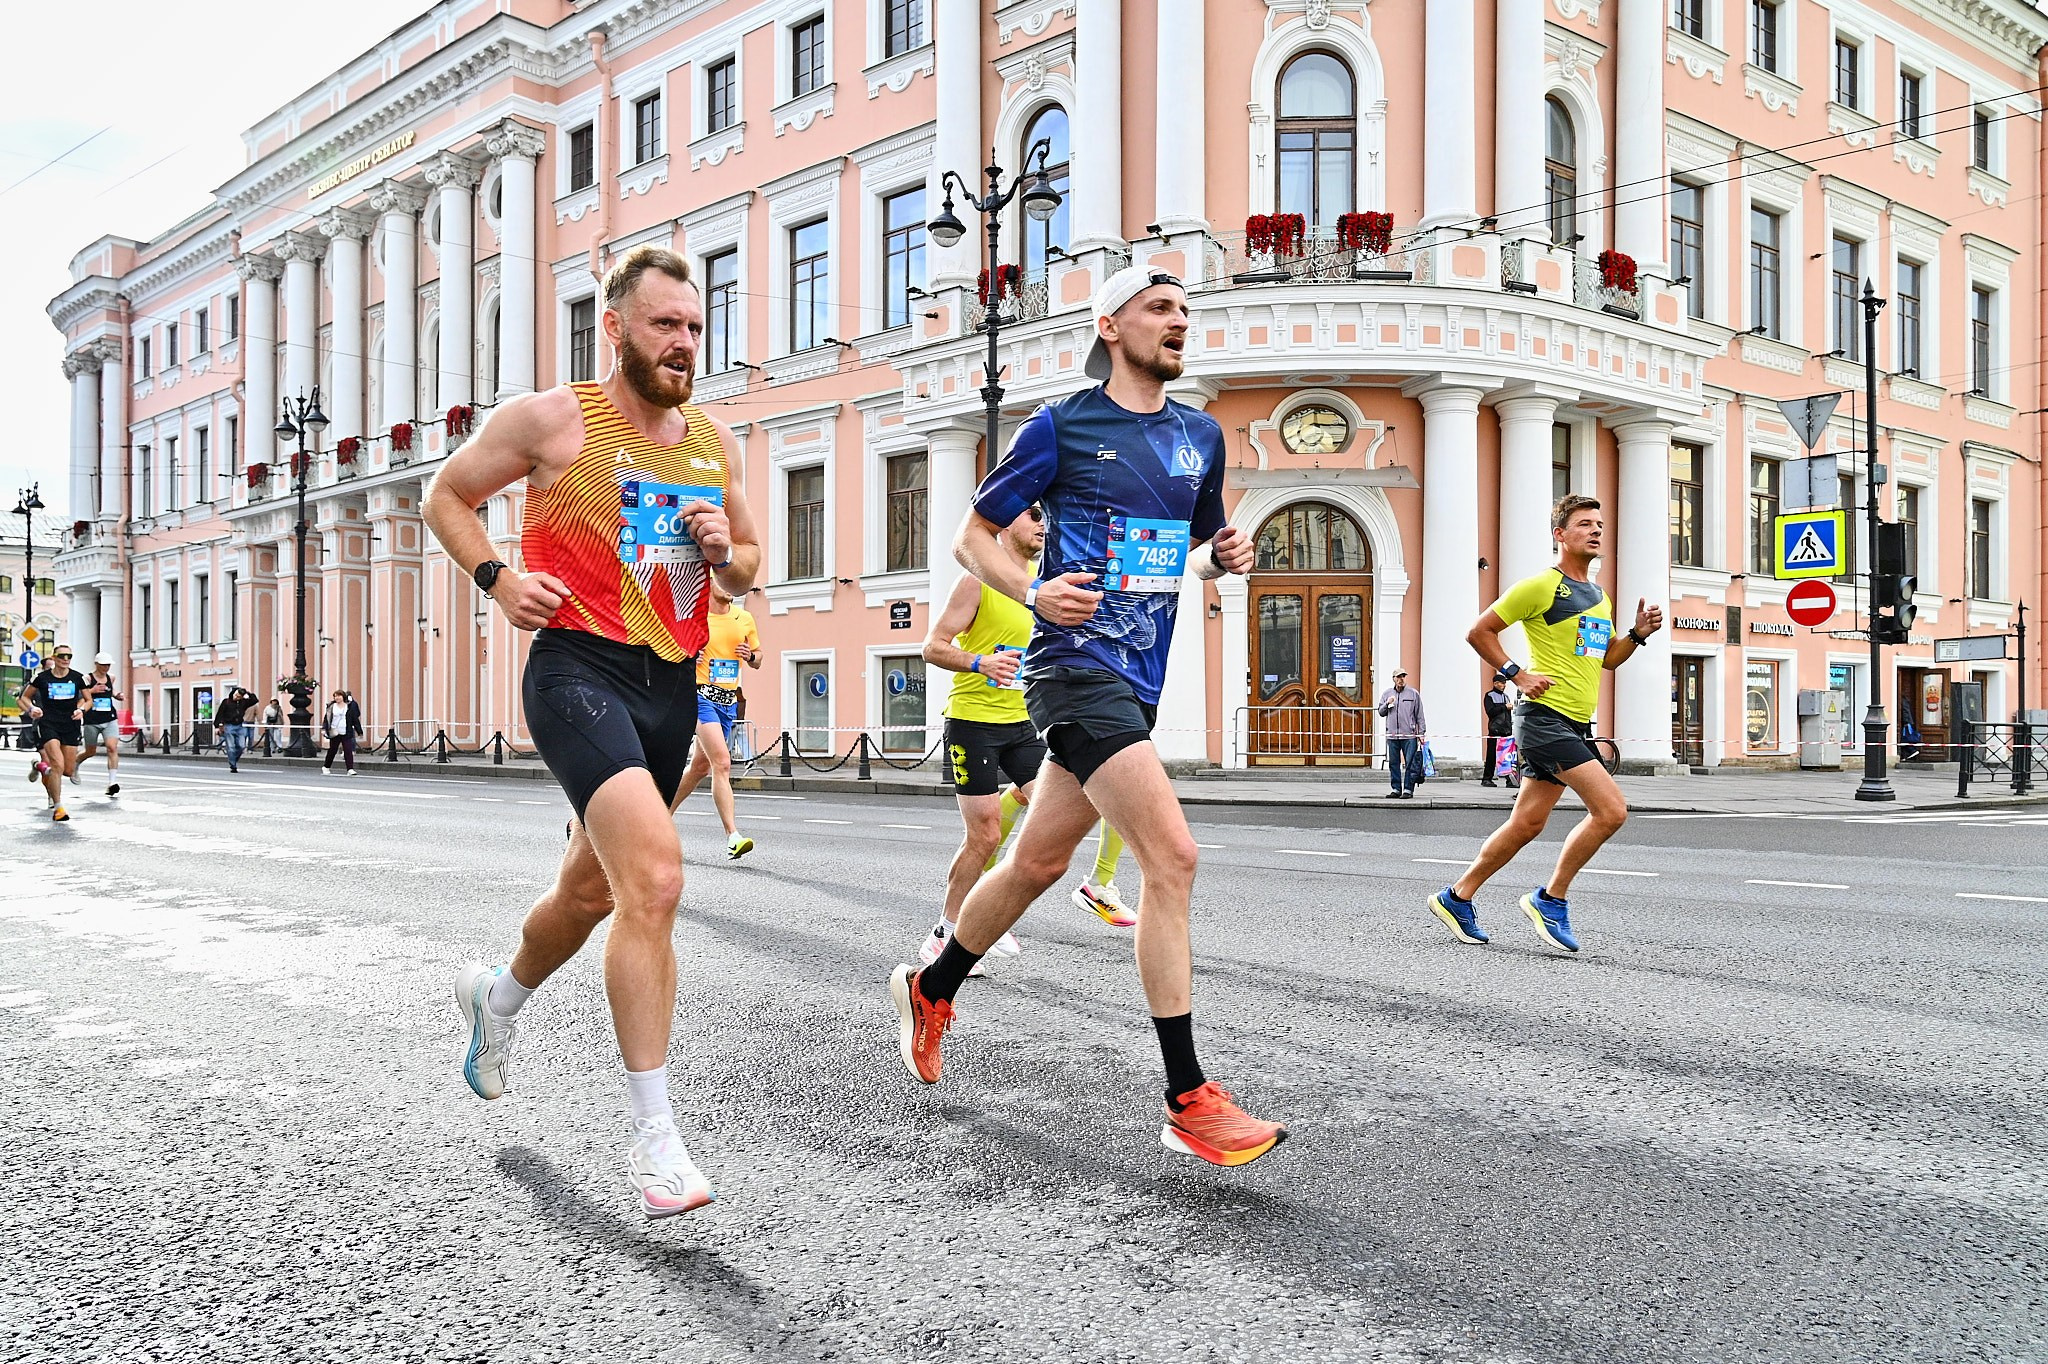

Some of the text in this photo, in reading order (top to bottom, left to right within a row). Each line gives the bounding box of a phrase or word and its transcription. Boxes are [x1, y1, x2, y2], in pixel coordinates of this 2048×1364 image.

[308, 130, 415, 199] БИЗНЕС-ЦЕНТР СЕНАТОР
[659, 536, 691, 544] ДМИТРИ
[1137, 547, 1178, 566] 7482
[1676, 617, 1721, 631] КОНФЕТЫ
[1752, 622, 1795, 637] ШОКОЛАД
[906, 682, 925, 692] БАН
[917, 1018, 927, 1052] balance
